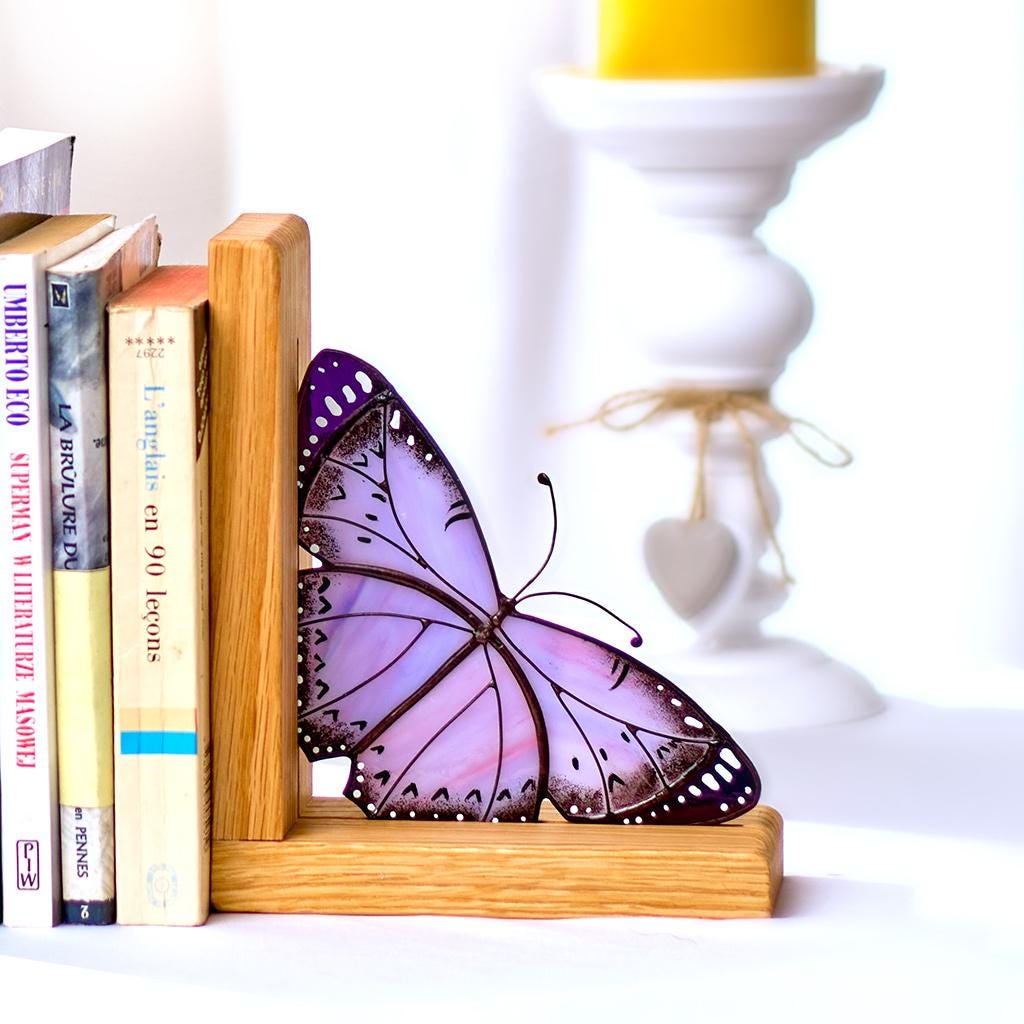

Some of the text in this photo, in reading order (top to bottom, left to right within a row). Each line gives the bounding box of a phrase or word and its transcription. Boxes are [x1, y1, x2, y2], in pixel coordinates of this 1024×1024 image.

[3, 284, 30, 426] UMBERTO ECO
[59, 404, 73, 432] LA
[60, 438, 77, 536] BRÛLURE
[144, 504, 158, 532] en
[145, 545, 166, 576] 90
[10, 453, 36, 768] SUPERMAN W LITERATURZE MASOWEJ
[142, 590, 167, 663] leçons
[75, 827, 88, 878] PENNES
